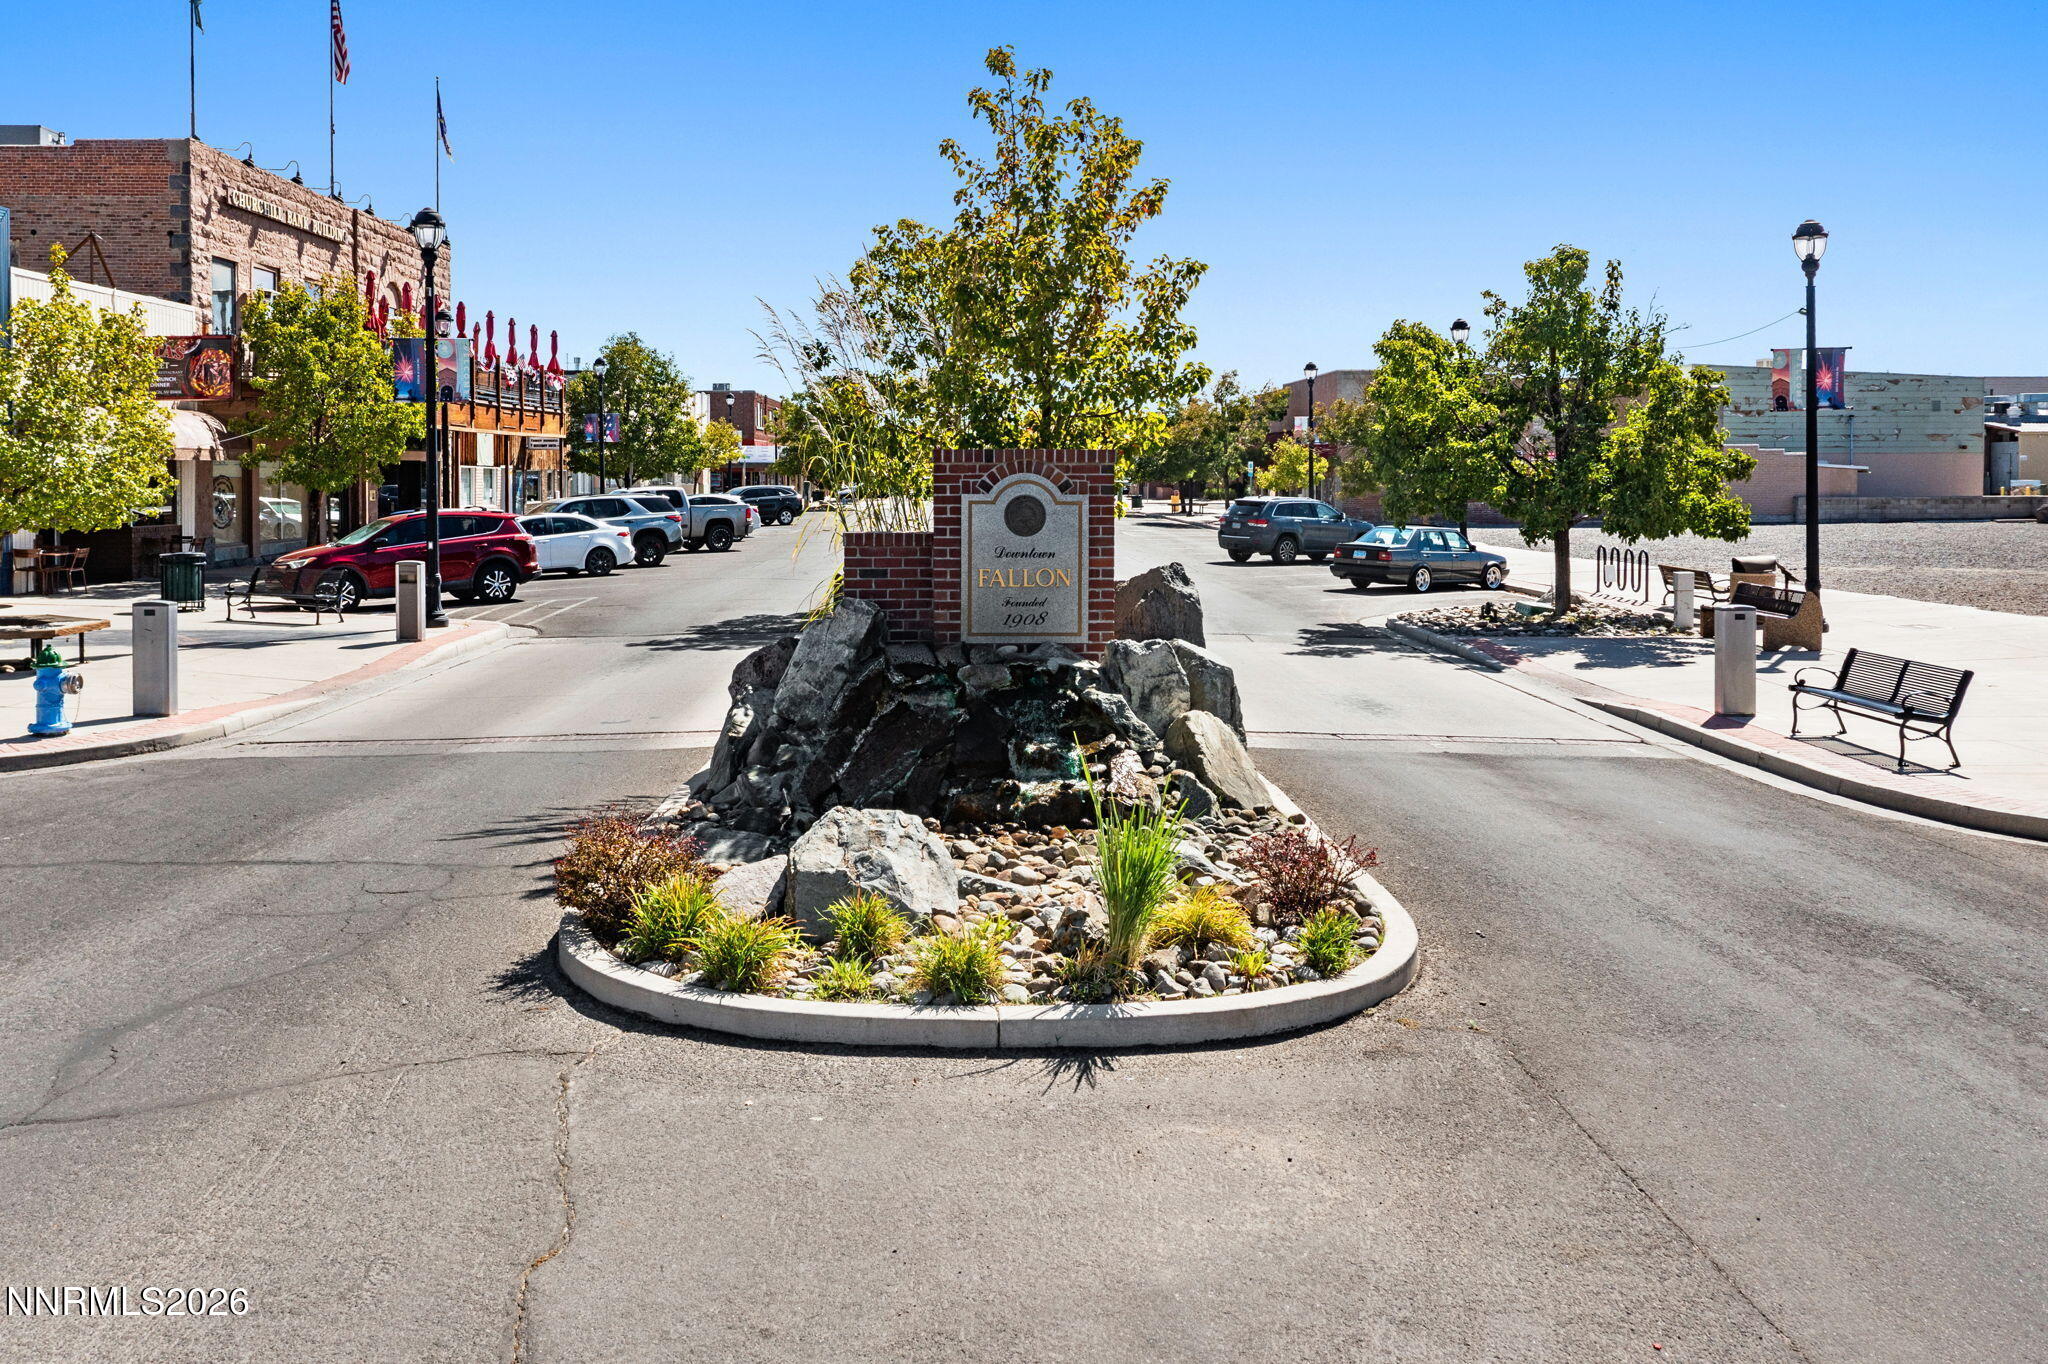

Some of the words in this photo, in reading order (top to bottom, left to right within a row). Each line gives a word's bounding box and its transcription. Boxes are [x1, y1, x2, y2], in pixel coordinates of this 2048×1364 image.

[232, 190, 285, 222] CHURCHILL
[287, 210, 309, 230] BANK
[312, 218, 347, 243] BUILDING
[994, 545, 1056, 559] Downtown
[977, 568, 1071, 588] FALLON
[1001, 596, 1048, 609] Founded
[1002, 612, 1049, 629] 1908
